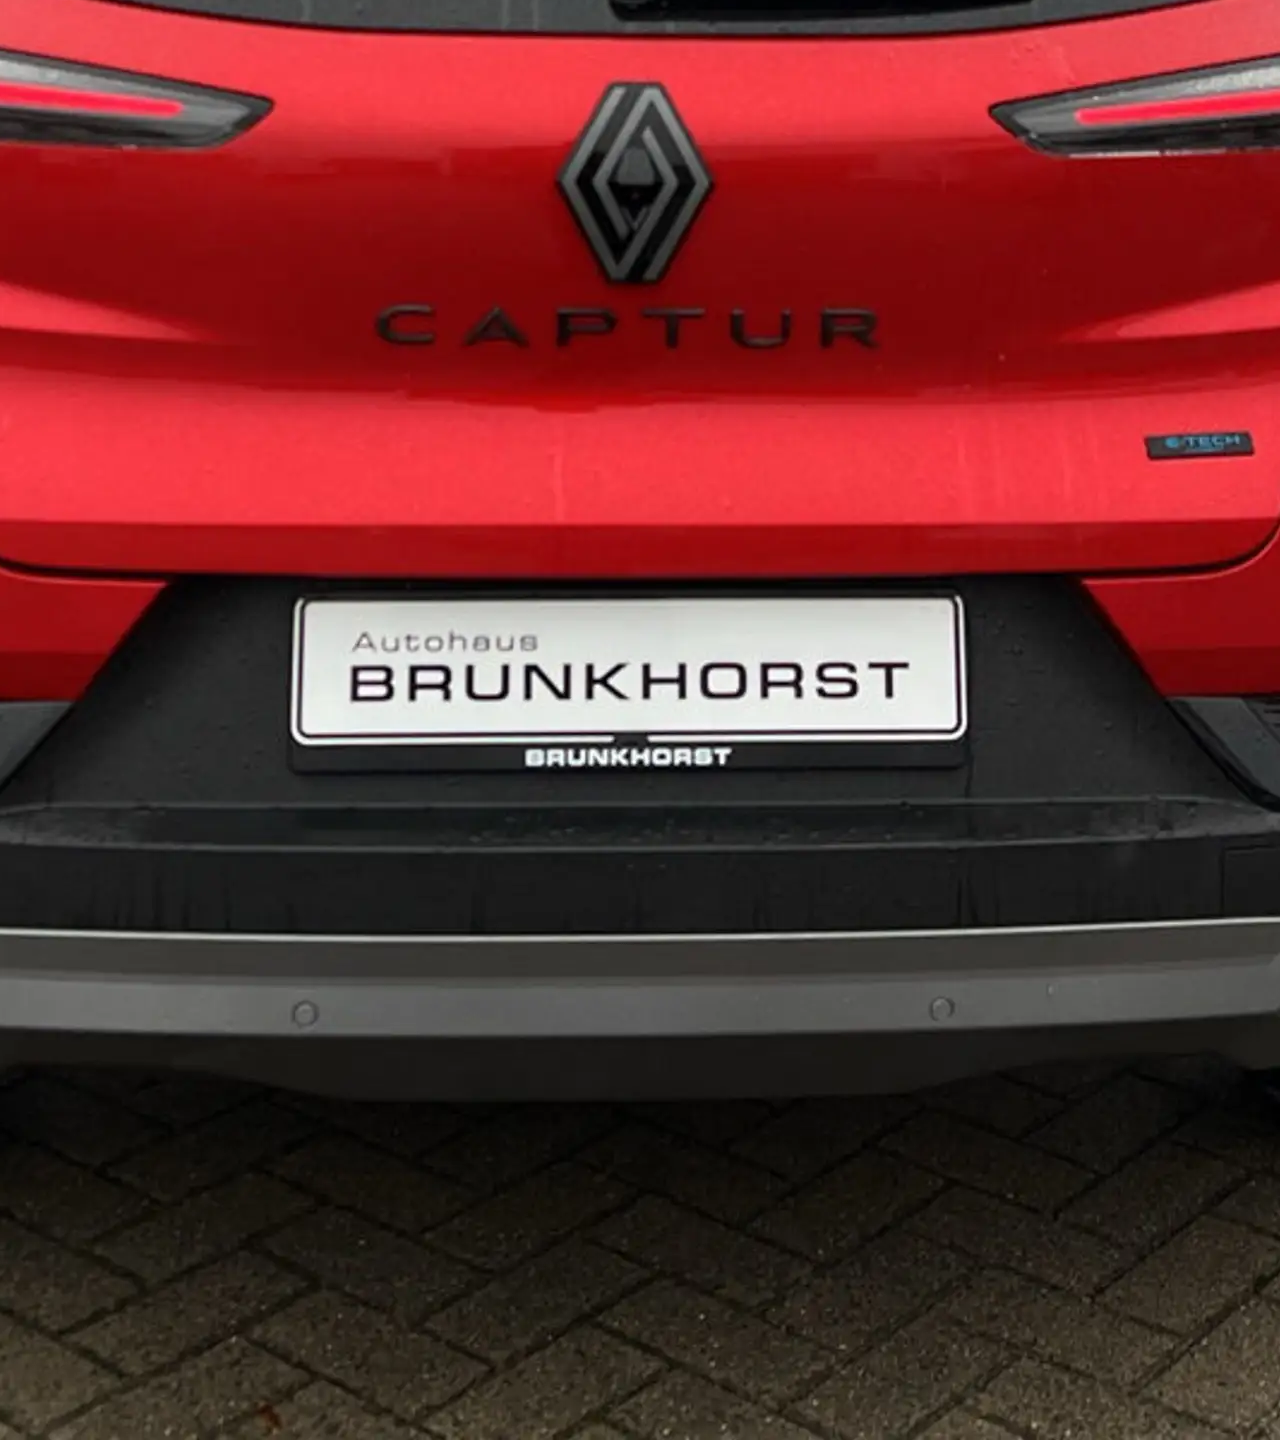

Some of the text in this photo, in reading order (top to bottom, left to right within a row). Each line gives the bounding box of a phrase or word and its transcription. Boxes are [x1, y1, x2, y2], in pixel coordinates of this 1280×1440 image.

[374, 303, 880, 350] CAPTUR
[351, 630, 539, 653] Autohaus
[349, 661, 911, 702] BRUNKHORST
[524, 747, 732, 767] BRUNKHORST
